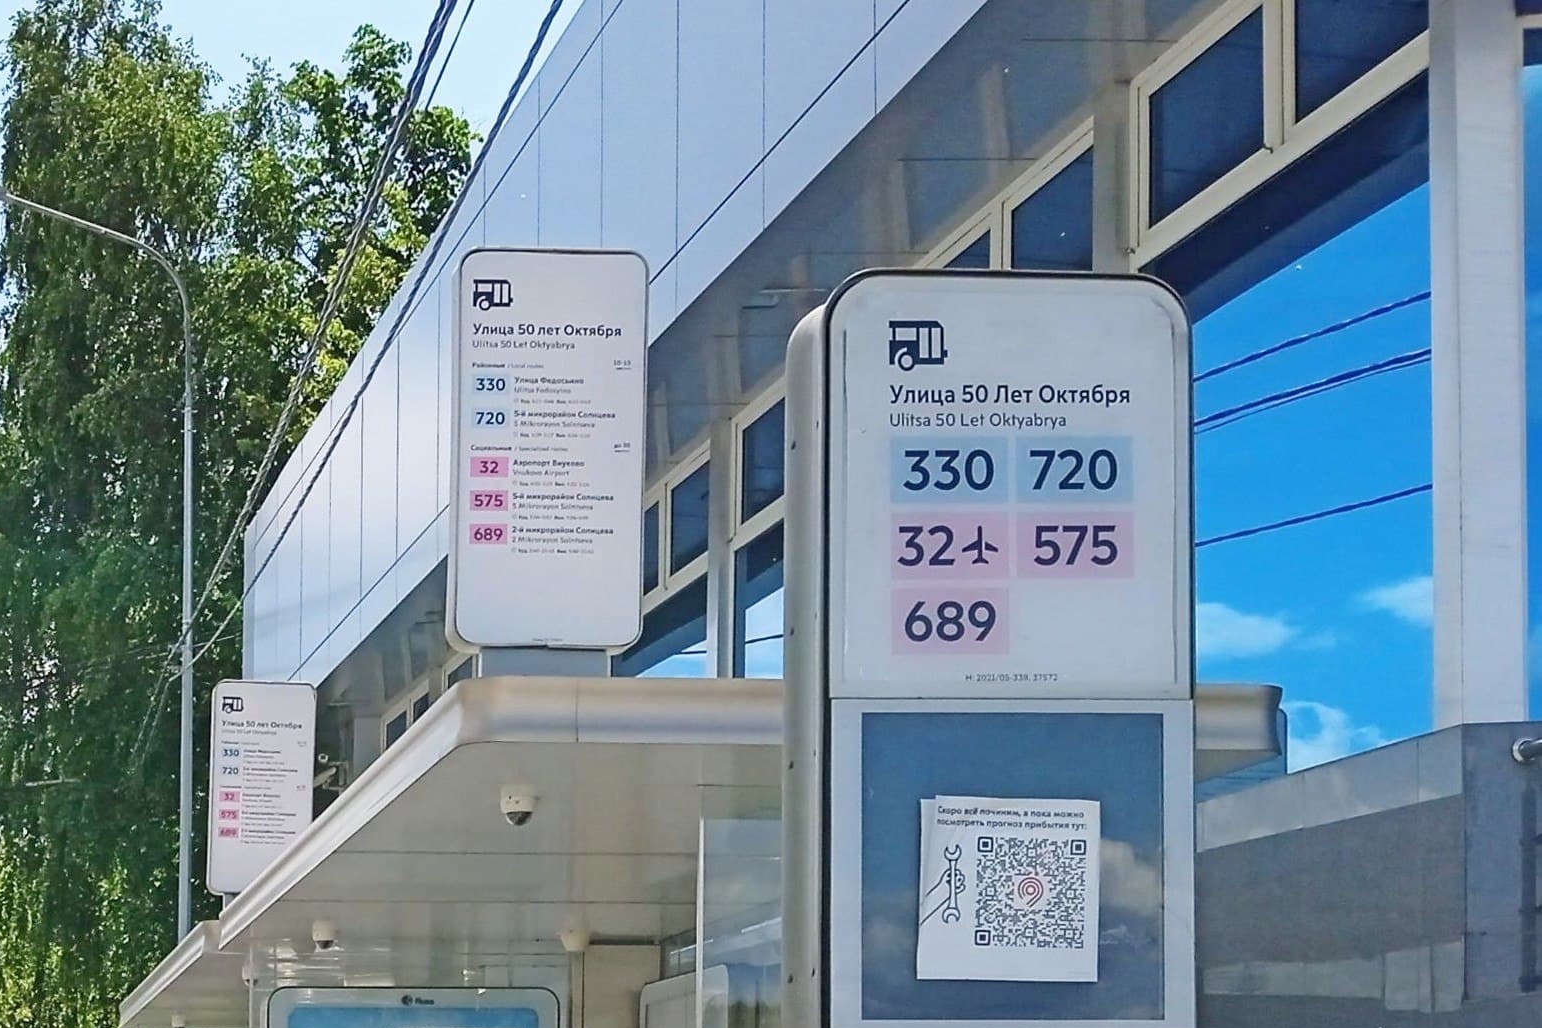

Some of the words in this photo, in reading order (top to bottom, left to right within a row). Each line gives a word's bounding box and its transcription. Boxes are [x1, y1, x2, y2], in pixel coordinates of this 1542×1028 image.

[473, 323, 514, 337] Улица
[518, 324, 535, 335] 50
[538, 326, 561, 336] лет
[564, 324, 622, 338] Октября
[472, 340, 498, 349] Ulitsa
[513, 341, 528, 349] Let
[530, 341, 575, 350] Oktyabrya
[476, 378, 506, 392] 330
[889, 385, 956, 407] Улица
[961, 385, 989, 404] 50
[993, 386, 1033, 404] Лет
[1038, 385, 1130, 408] Октября
[475, 412, 505, 425] 720
[889, 413, 931, 428] Ulitsa
[936, 414, 955, 427] 50
[960, 413, 985, 427] Let
[989, 413, 1066, 431] Oktyabrya
[479, 461, 499, 474] 32
[903, 449, 994, 491] 330
[1029, 449, 1117, 491] 720
[474, 494, 503, 507] 575
[474, 528, 503, 541] 689
[897, 526, 955, 567] 32
[1033, 525, 1117, 567] 575
[904, 601, 996, 642] 689
[246, 720, 256, 728] 50
[223, 749, 239, 757] 330
[222, 767, 239, 775] 720
[937, 805, 962, 816] Скоро
[979, 809, 1021, 817] починим,
[936, 818, 985, 827] посмотреть
[986, 820, 1022, 830] прогноз
[1024, 821, 1069, 830] прибытия
